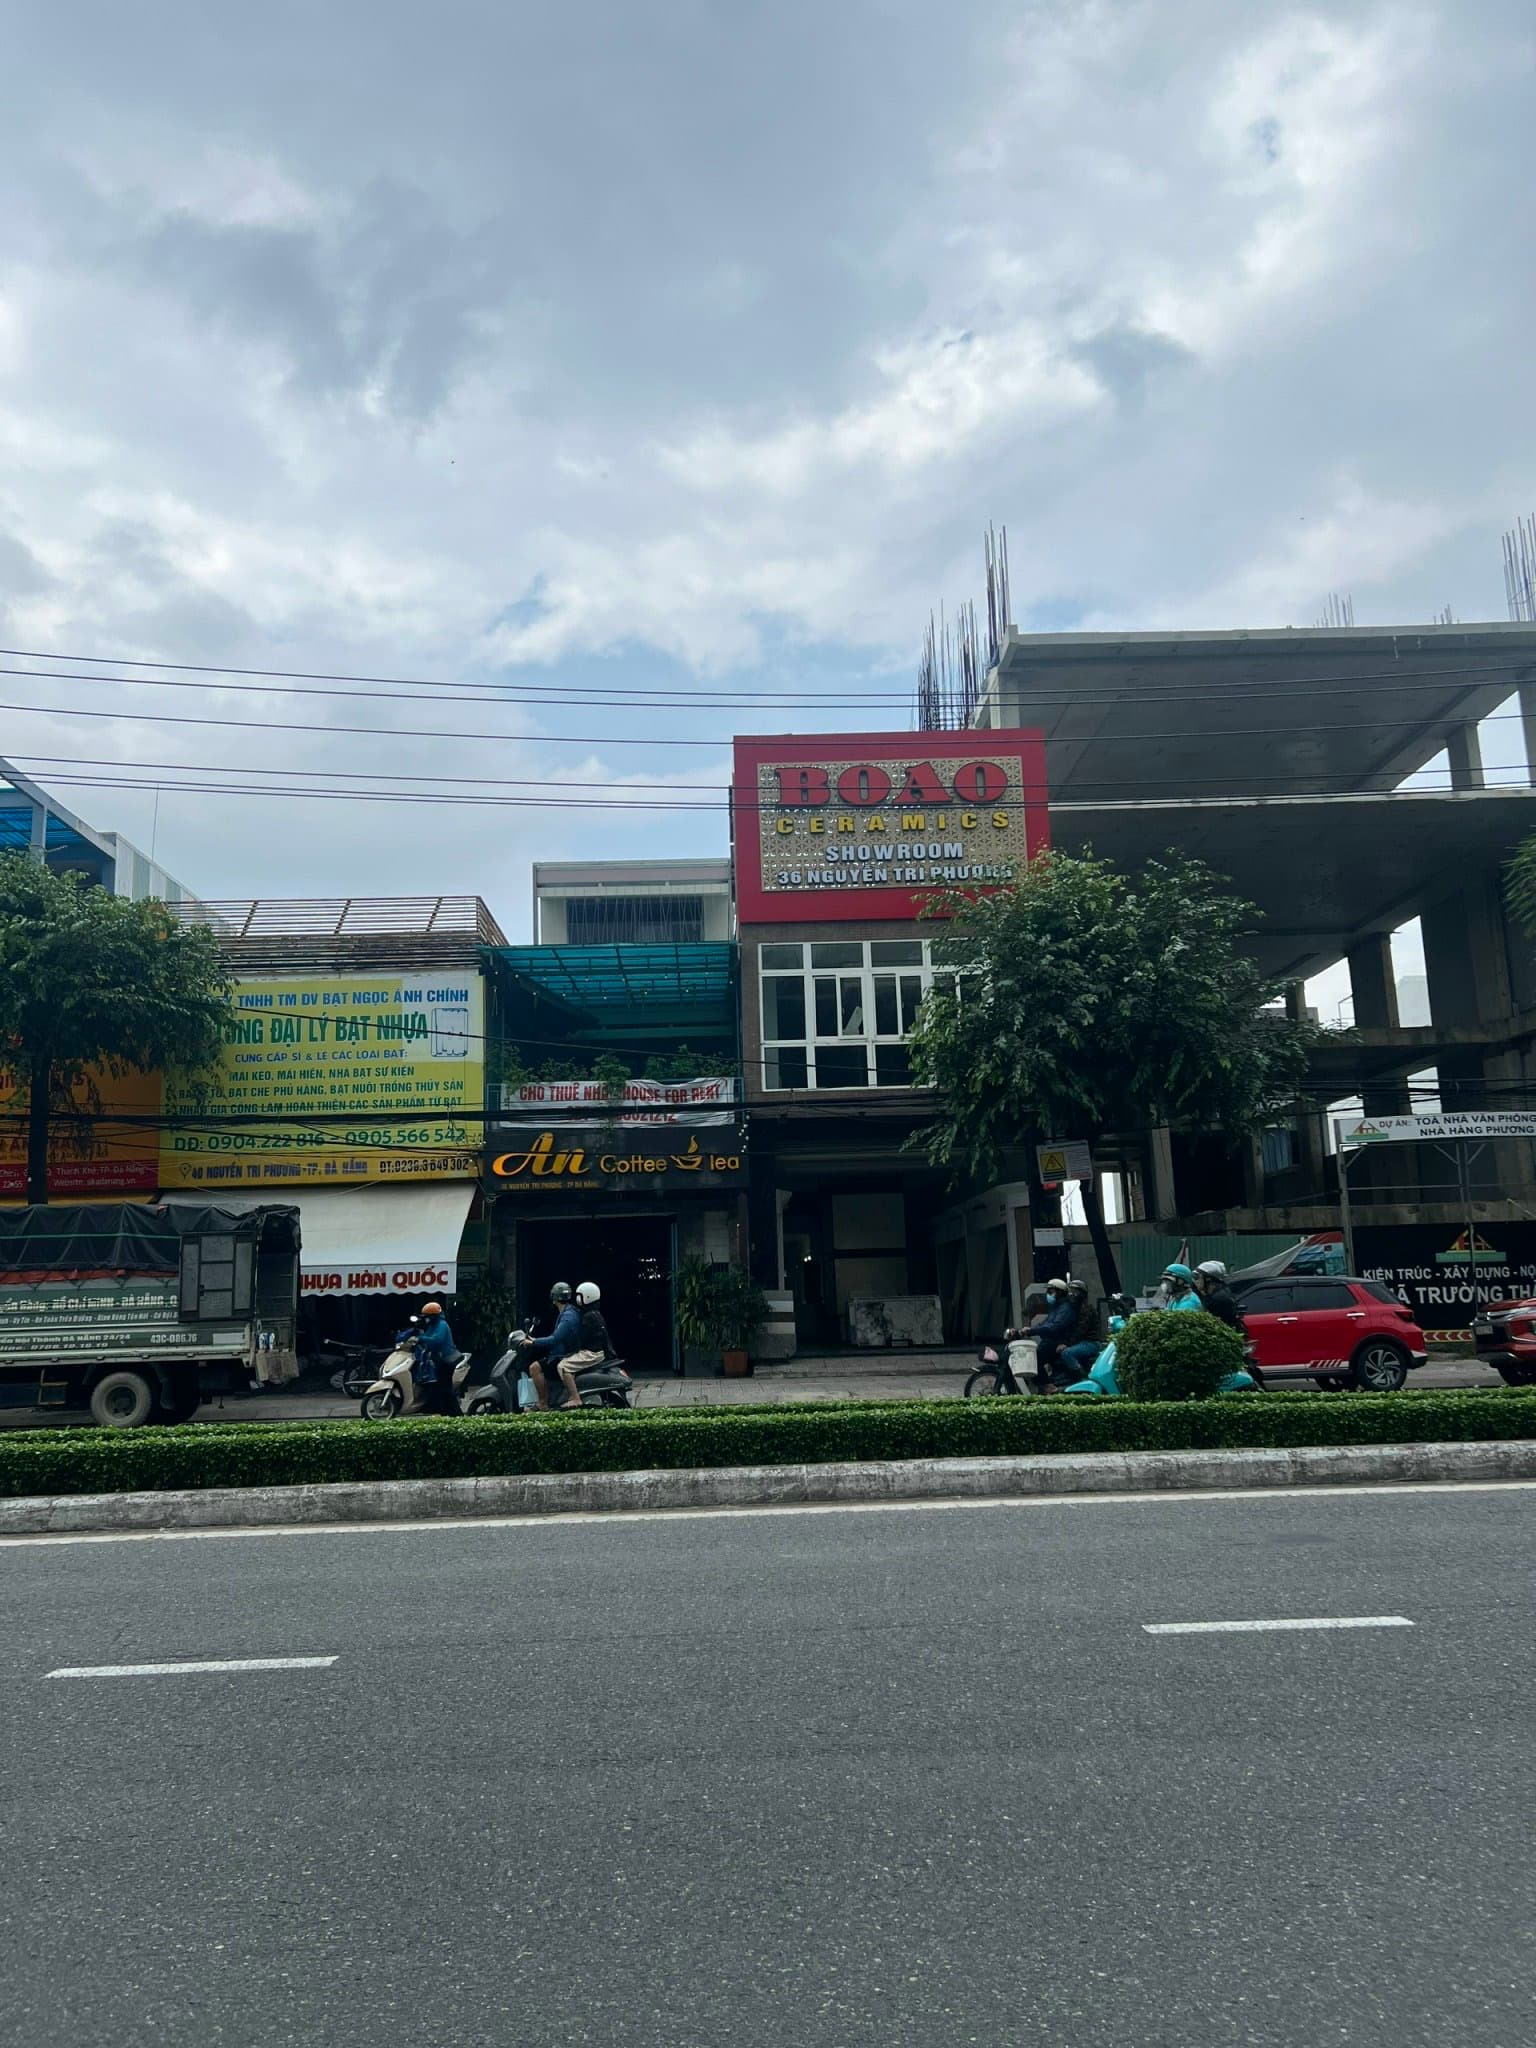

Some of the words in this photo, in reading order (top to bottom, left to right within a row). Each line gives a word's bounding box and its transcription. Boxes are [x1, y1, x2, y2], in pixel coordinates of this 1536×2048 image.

[775, 761, 1009, 807] BOAO
[777, 811, 1010, 834] CERAMICS
[826, 842, 964, 862] SHOWROOM
[778, 870, 801, 886] 36
[807, 864, 888, 884] NGUYỄN
[893, 867, 924, 882] TRI
[237, 994, 273, 1007] TNHH
[278, 993, 297, 1006] TM
[322, 992, 348, 1007] BẠT
[352, 991, 389, 1006] NGỌC
[427, 987, 468, 1002] CHÍNH
[270, 1017, 300, 1047] ĐẠI
[309, 1012, 328, 1041] LÝ
[335, 1015, 371, 1045] BẠT
[376, 1011, 429, 1043] NHỰA
[235, 1053, 262, 1063] CUNG
[306, 1053, 313, 1061] &
[251, 1087, 270, 1097] CHE
[519, 1086, 545, 1101] CHO
[549, 1082, 581, 1101] THUÊ
[665, 1088, 688, 1104] FOR
[1444, 1113, 1468, 1124] NHÀ
[208, 1133, 292, 1150] 0904.222
[345, 1129, 429, 1146] 0905.566
[434, 1128, 465, 1143] 542
[1420, 1125, 1446, 1136] NHÀ
[1449, 1124, 1483, 1135] HÀNG
[450, 1158, 468, 1171] 302
[492, 1132, 589, 1176] An
[347, 1270, 387, 1289] HÀN
[392, 1265, 448, 1289] QUỐC
[1397, 1265, 1432, 1280] TRÚC
[1443, 1264, 1470, 1279] XÂY
[1475, 1266, 1511, 1281] DỰNG
[1415, 1282, 1504, 1304] TRƯỜNG
